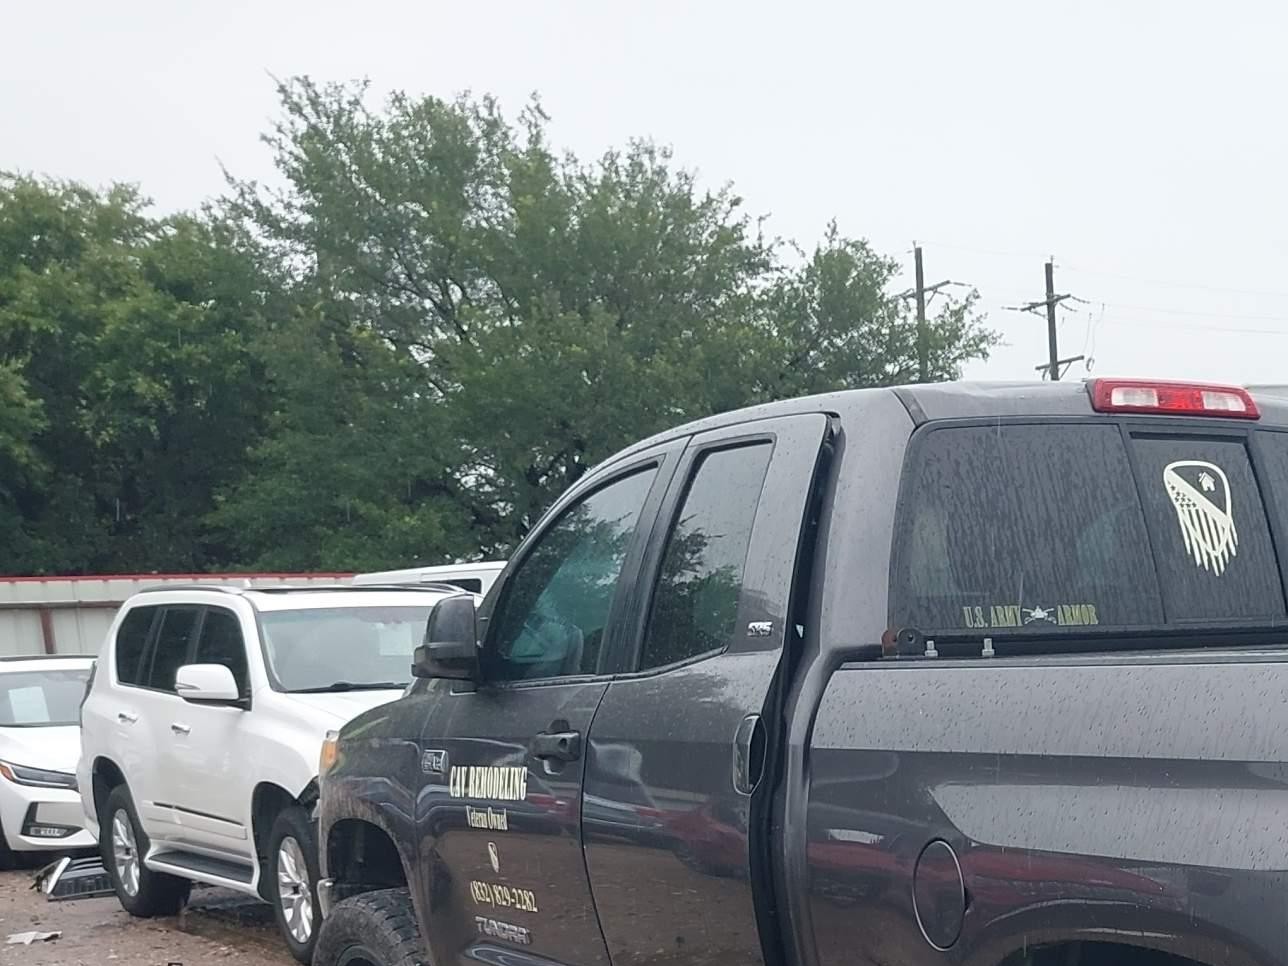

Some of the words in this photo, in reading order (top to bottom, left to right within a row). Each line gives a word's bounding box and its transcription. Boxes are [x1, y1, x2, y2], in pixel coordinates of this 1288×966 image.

[963, 605, 988, 628] U.S.
[990, 604, 1022, 628] ARMY
[1057, 603, 1099, 626] ARMOR
[450, 765, 468, 797] CAV
[468, 765, 528, 800] REMODELING
[470, 880, 495, 909] (832)
[493, 884, 538, 913] 829-2282
